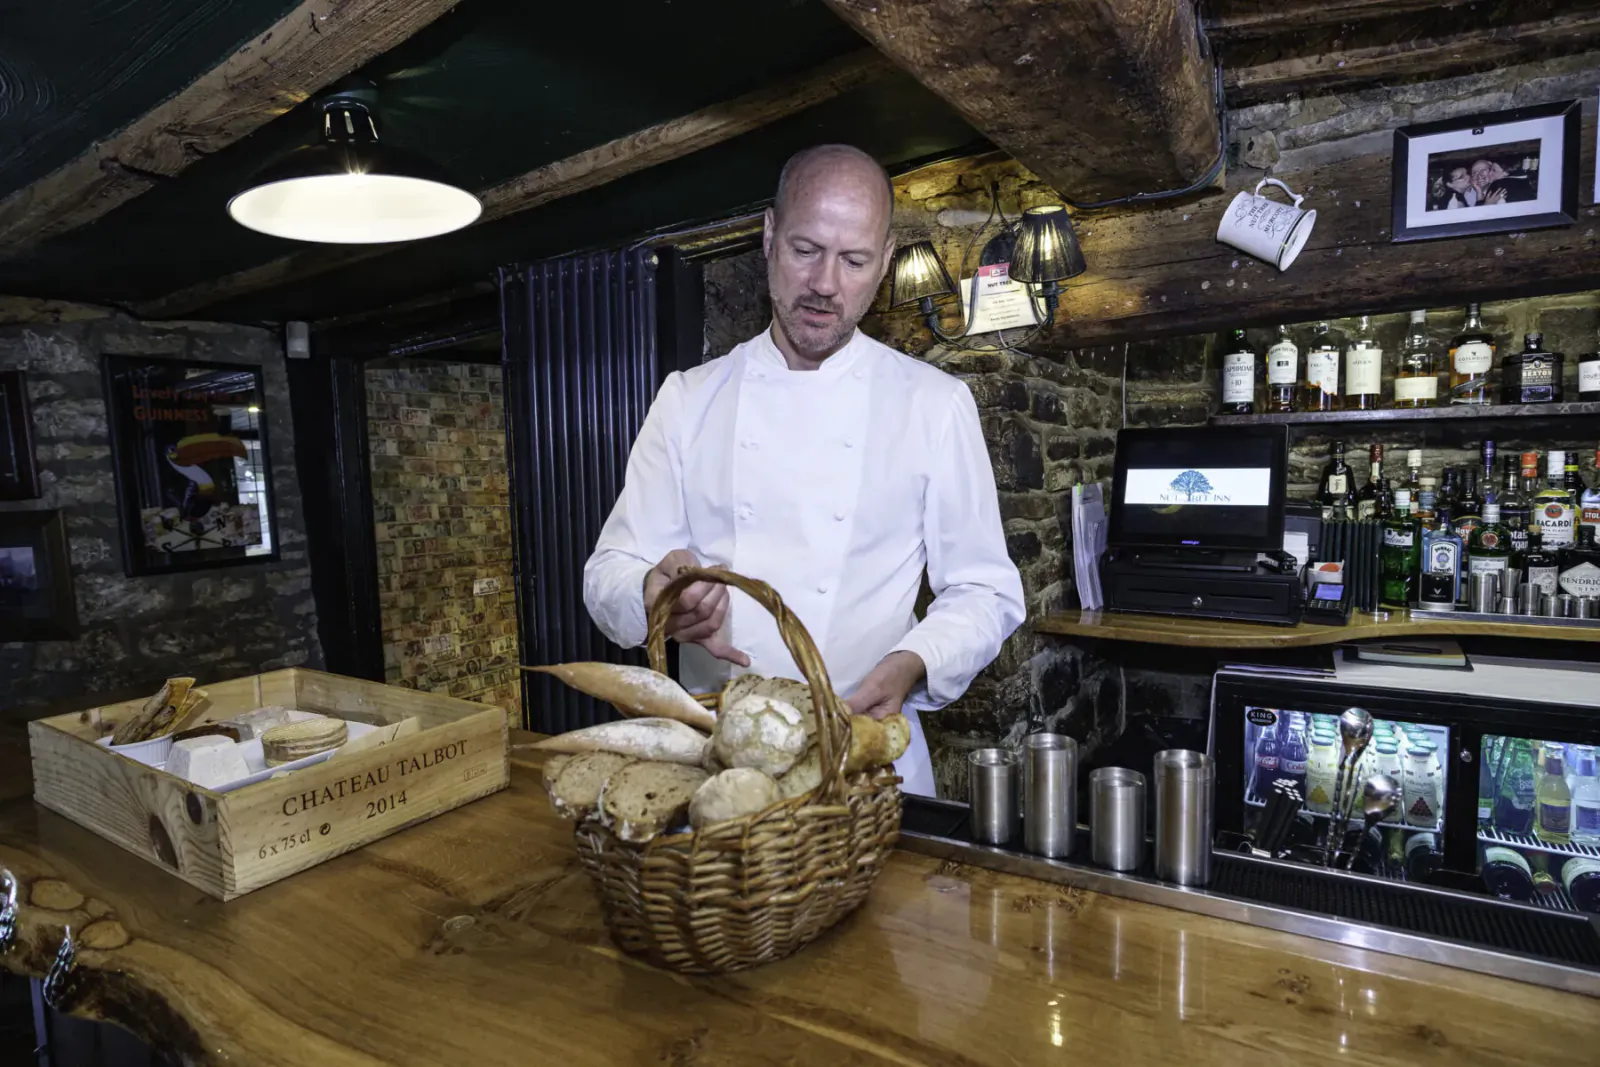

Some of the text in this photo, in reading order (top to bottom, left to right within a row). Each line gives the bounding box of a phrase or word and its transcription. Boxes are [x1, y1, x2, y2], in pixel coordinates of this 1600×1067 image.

[1250, 711, 1273, 720] KING
[282, 739, 468, 817] CHATEAU TALBOT
[366, 789, 408, 820] 2014
[258, 828, 311, 860] 6 x 75 cl
